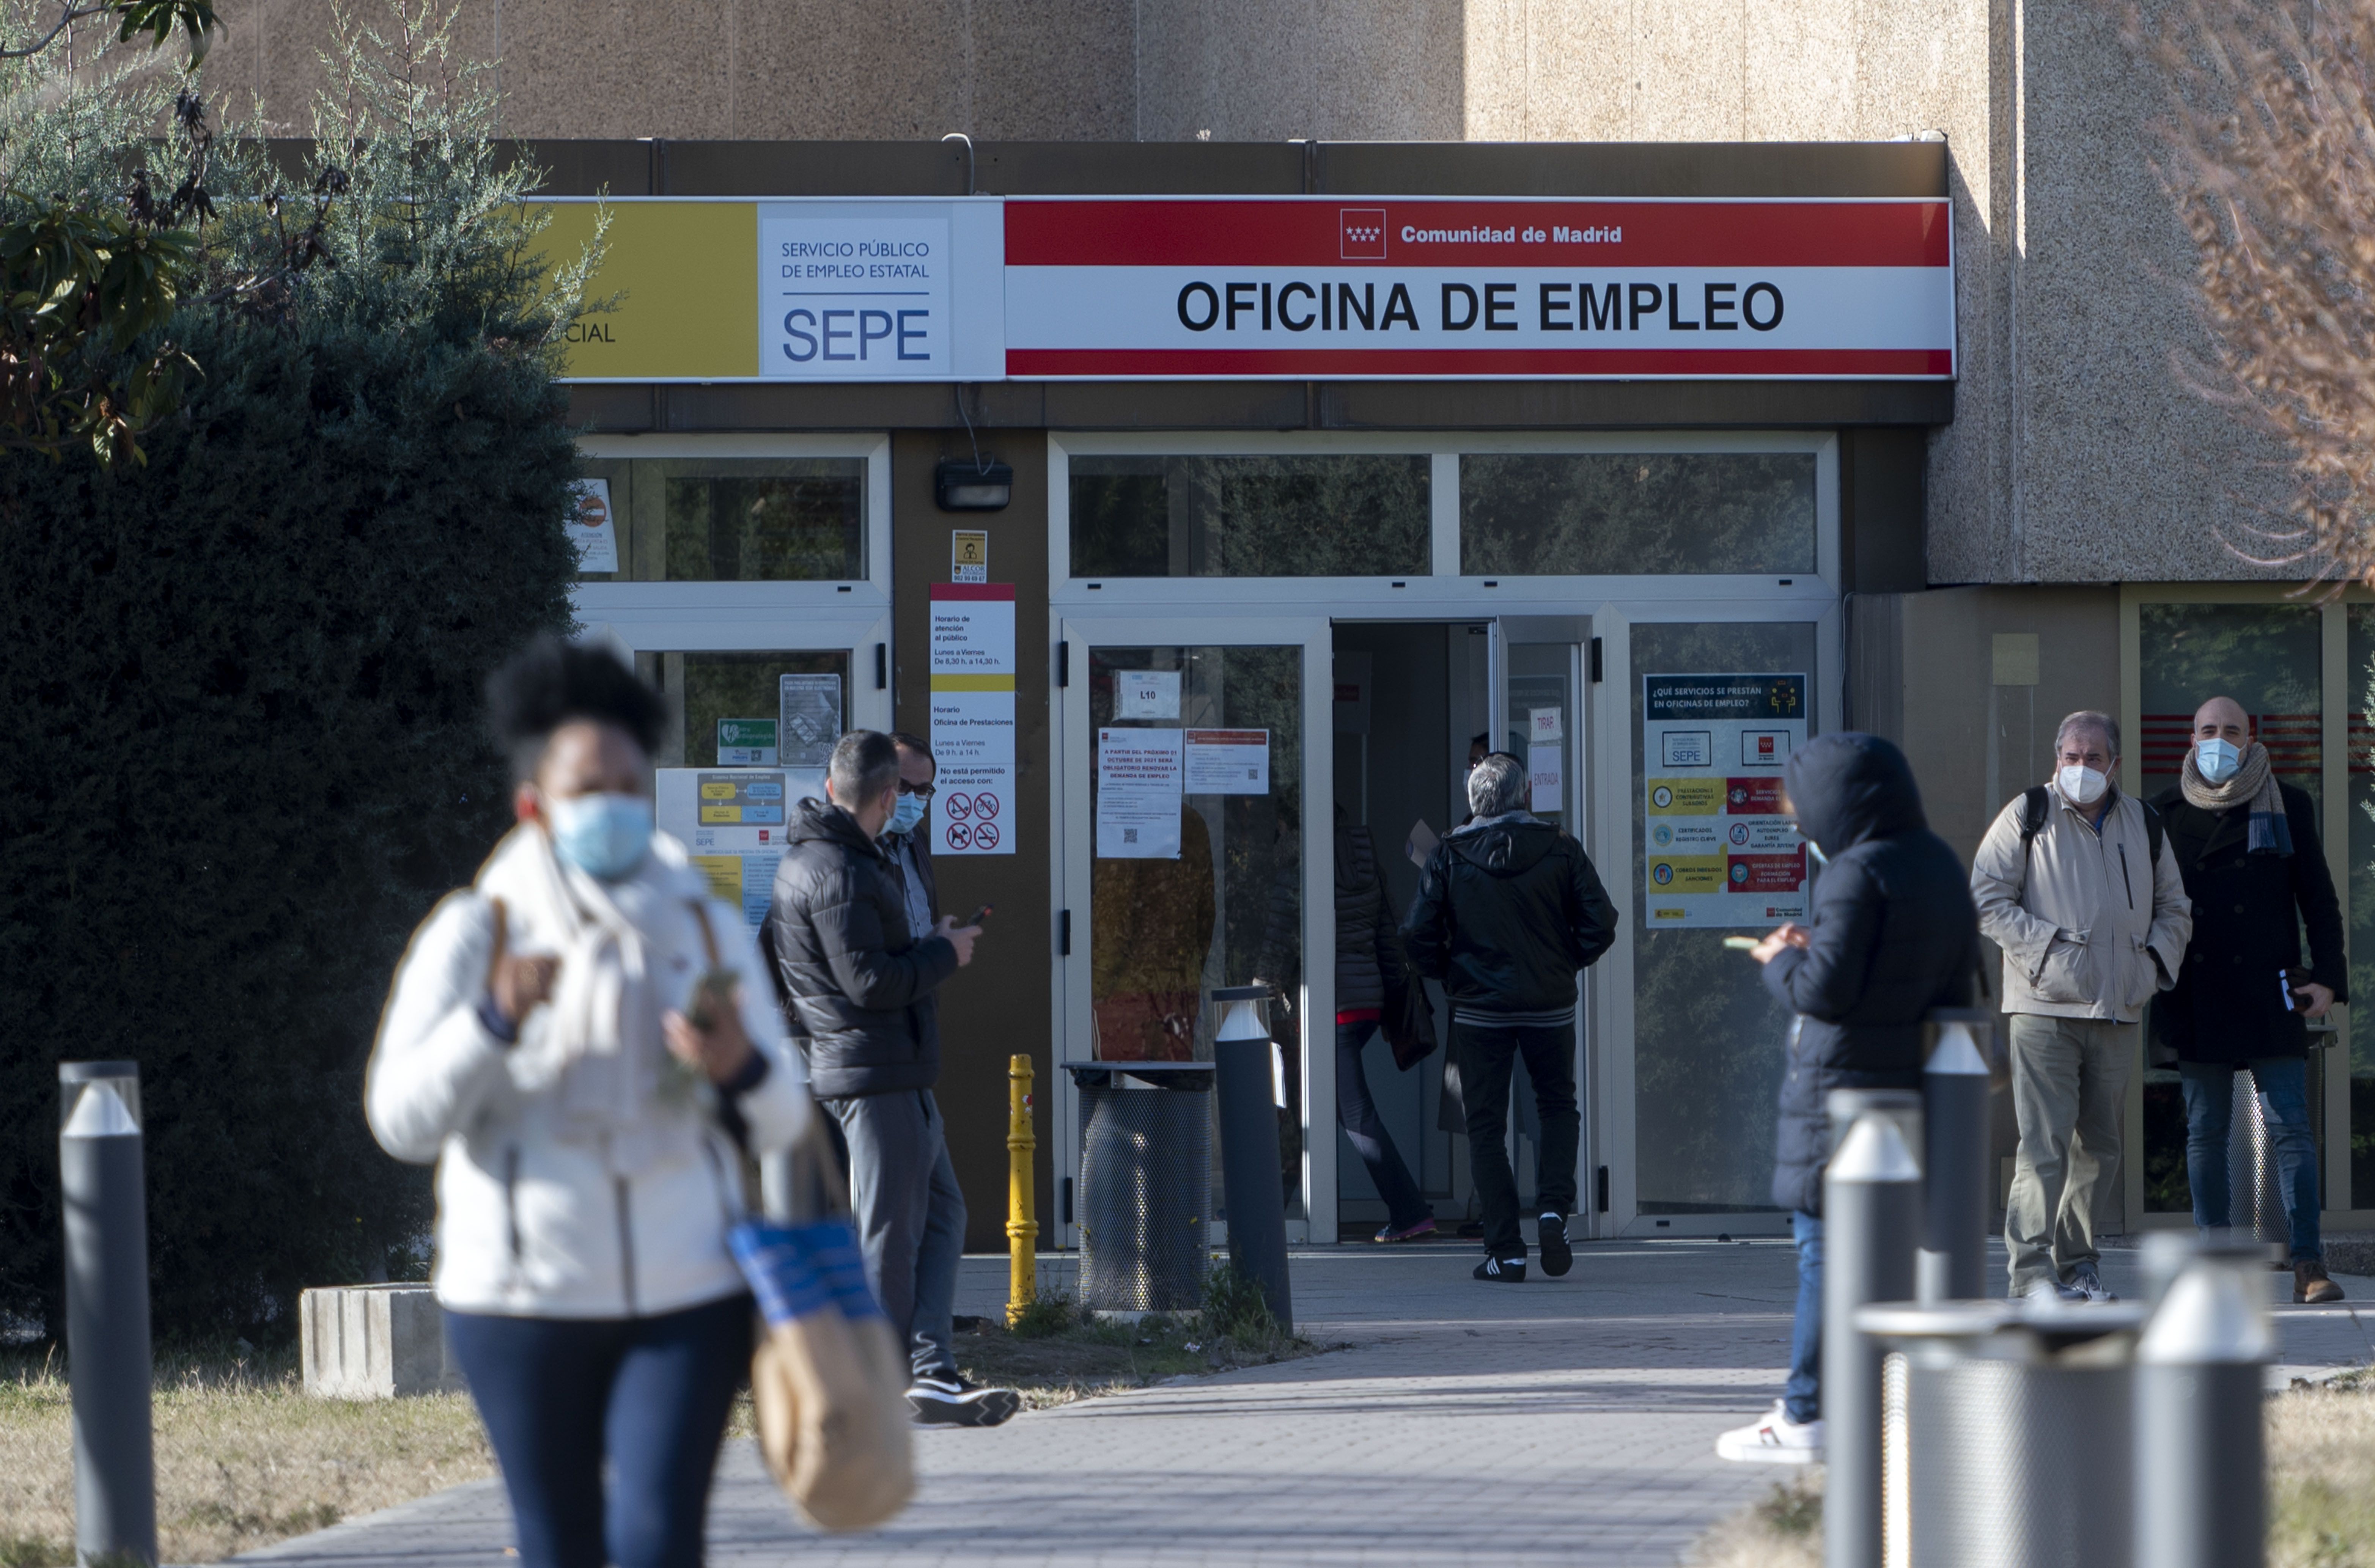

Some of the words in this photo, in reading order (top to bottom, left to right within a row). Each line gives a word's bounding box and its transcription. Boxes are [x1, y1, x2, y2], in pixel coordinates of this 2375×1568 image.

[1400, 225, 1515, 245] Comunidad
[1521, 226, 1547, 244] de
[1552, 225, 1623, 244] Madrid
[782, 242, 854, 258] SERVICIO
[859, 238, 930, 258] PÚBLICO
[782, 264, 802, 279] DE
[807, 264, 865, 279] EMPLEO
[869, 264, 930, 278] ESTATAL
[1175, 281, 1420, 333] OFICINA
[1442, 282, 1520, 331] DE
[1538, 281, 1786, 332] EMPLEO
[565, 323, 616, 343] CIAL
[782, 308, 931, 362] SEPE
[945, 658, 960, 666] 8,30
[975, 658, 993, 666] 14,30
[1140, 691, 1156, 699] L10
[1653, 687, 1672, 698] ¿QUÉ
[1674, 687, 1714, 696] SERVICIOS
[1717, 687, 1726, 695] SE
[1727, 687, 1762, 695] PRESTAN
[1666, 699, 1702, 708] OFICINAS
[1715, 699, 1749, 707] EMPLEO?
[1537, 716, 1554, 730] TIRAR
[1672, 750, 1701, 762] SEPE
[970, 768, 1005, 776] permitido
[1534, 772, 1559, 786] ENTRADA
